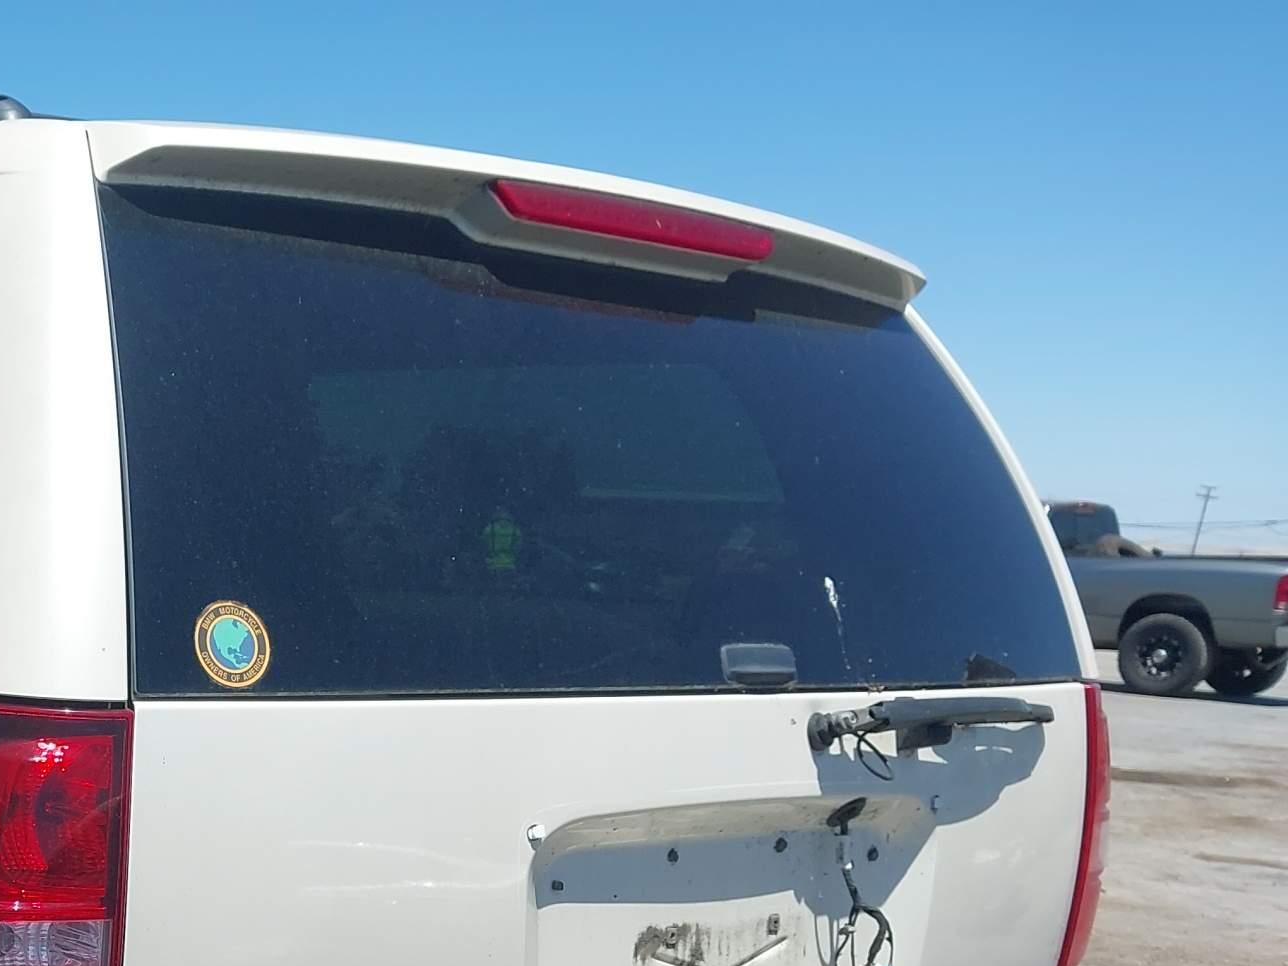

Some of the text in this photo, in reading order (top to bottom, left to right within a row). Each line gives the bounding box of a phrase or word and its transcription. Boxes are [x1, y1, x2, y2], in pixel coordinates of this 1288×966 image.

[201, 606, 262, 636] BMW MOTORCYCLE
[201, 651, 228, 680] OWNERS
[243, 654, 265, 681] AMERICA
